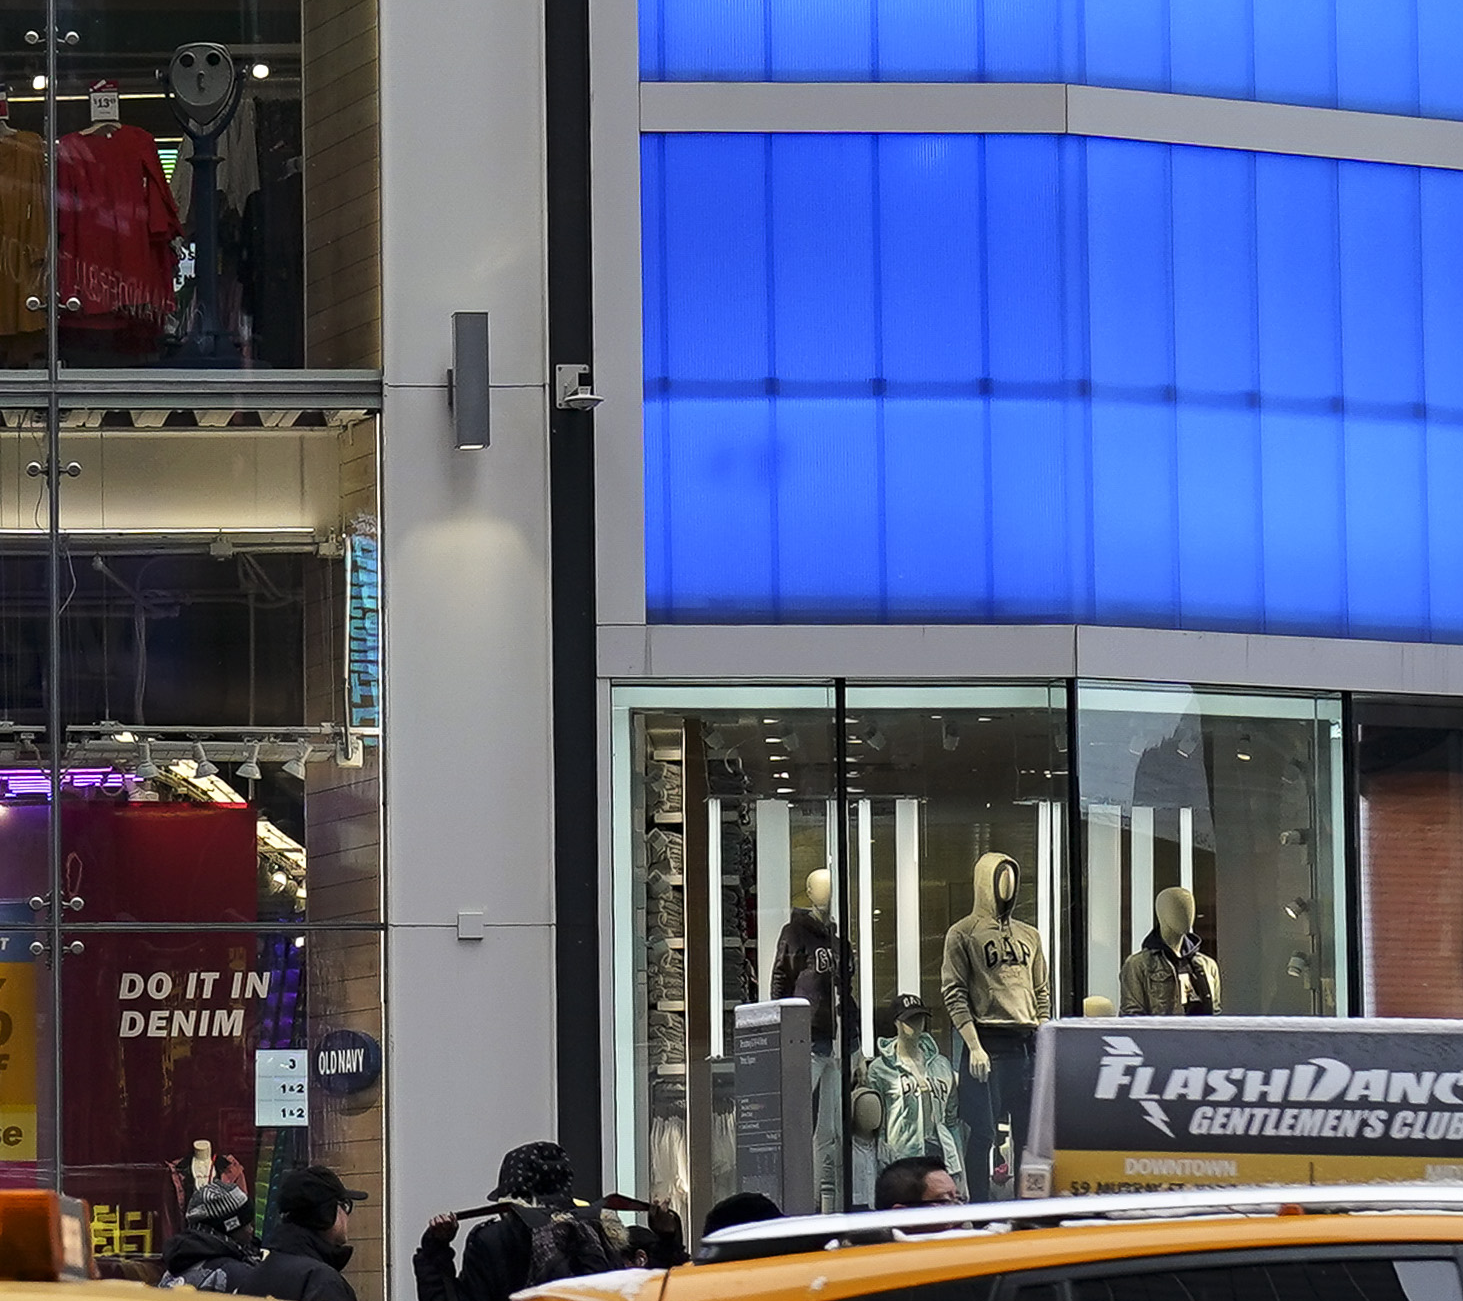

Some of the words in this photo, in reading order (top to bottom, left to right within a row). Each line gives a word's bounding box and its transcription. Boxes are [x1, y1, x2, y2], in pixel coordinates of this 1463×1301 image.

[983, 936, 1032, 969] GAP
[118, 971, 173, 1000] DO
[185, 971, 220, 999] IT
[230, 971, 271, 999] IN
[118, 1009, 246, 1038] DENIM
[318, 1050, 337, 1075] OLD
[338, 1048, 365, 1074] NAVY
[1188, 1105, 1387, 1140] GENTLEMEN'S
[1123, 1157, 1239, 1177] DOWNTOWN
